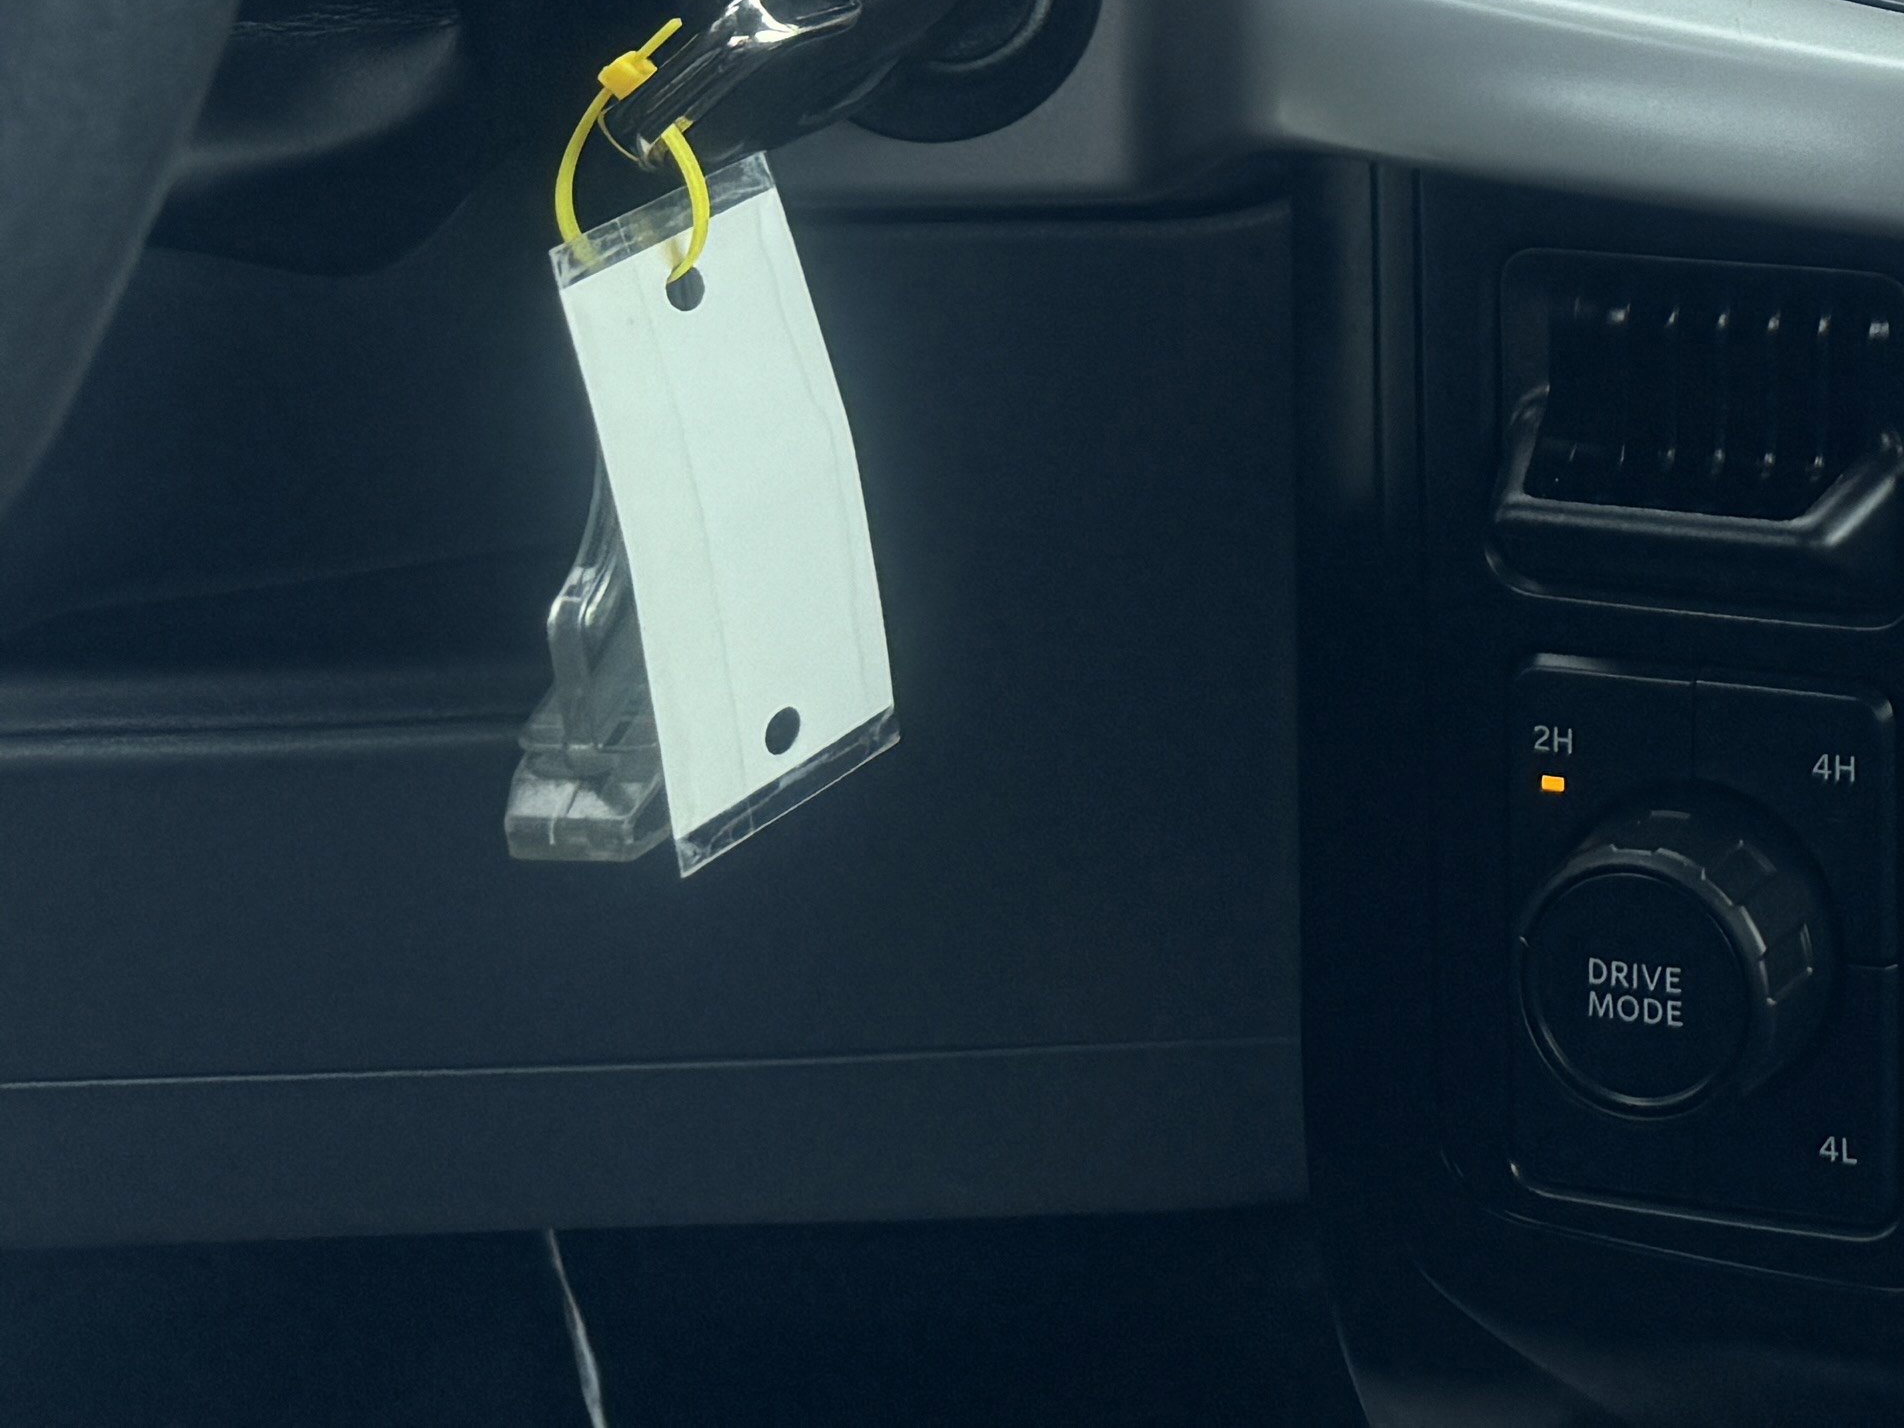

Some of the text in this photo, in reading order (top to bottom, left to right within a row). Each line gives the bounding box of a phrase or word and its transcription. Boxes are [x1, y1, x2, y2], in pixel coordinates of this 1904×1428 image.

[1533, 724, 1574, 755] 2H
[1812, 753, 1856, 784] 4H
[1588, 958, 1683, 994] DRIVE
[1588, 992, 1683, 1027] MODE
[1819, 1136, 1858, 1165] 4L
